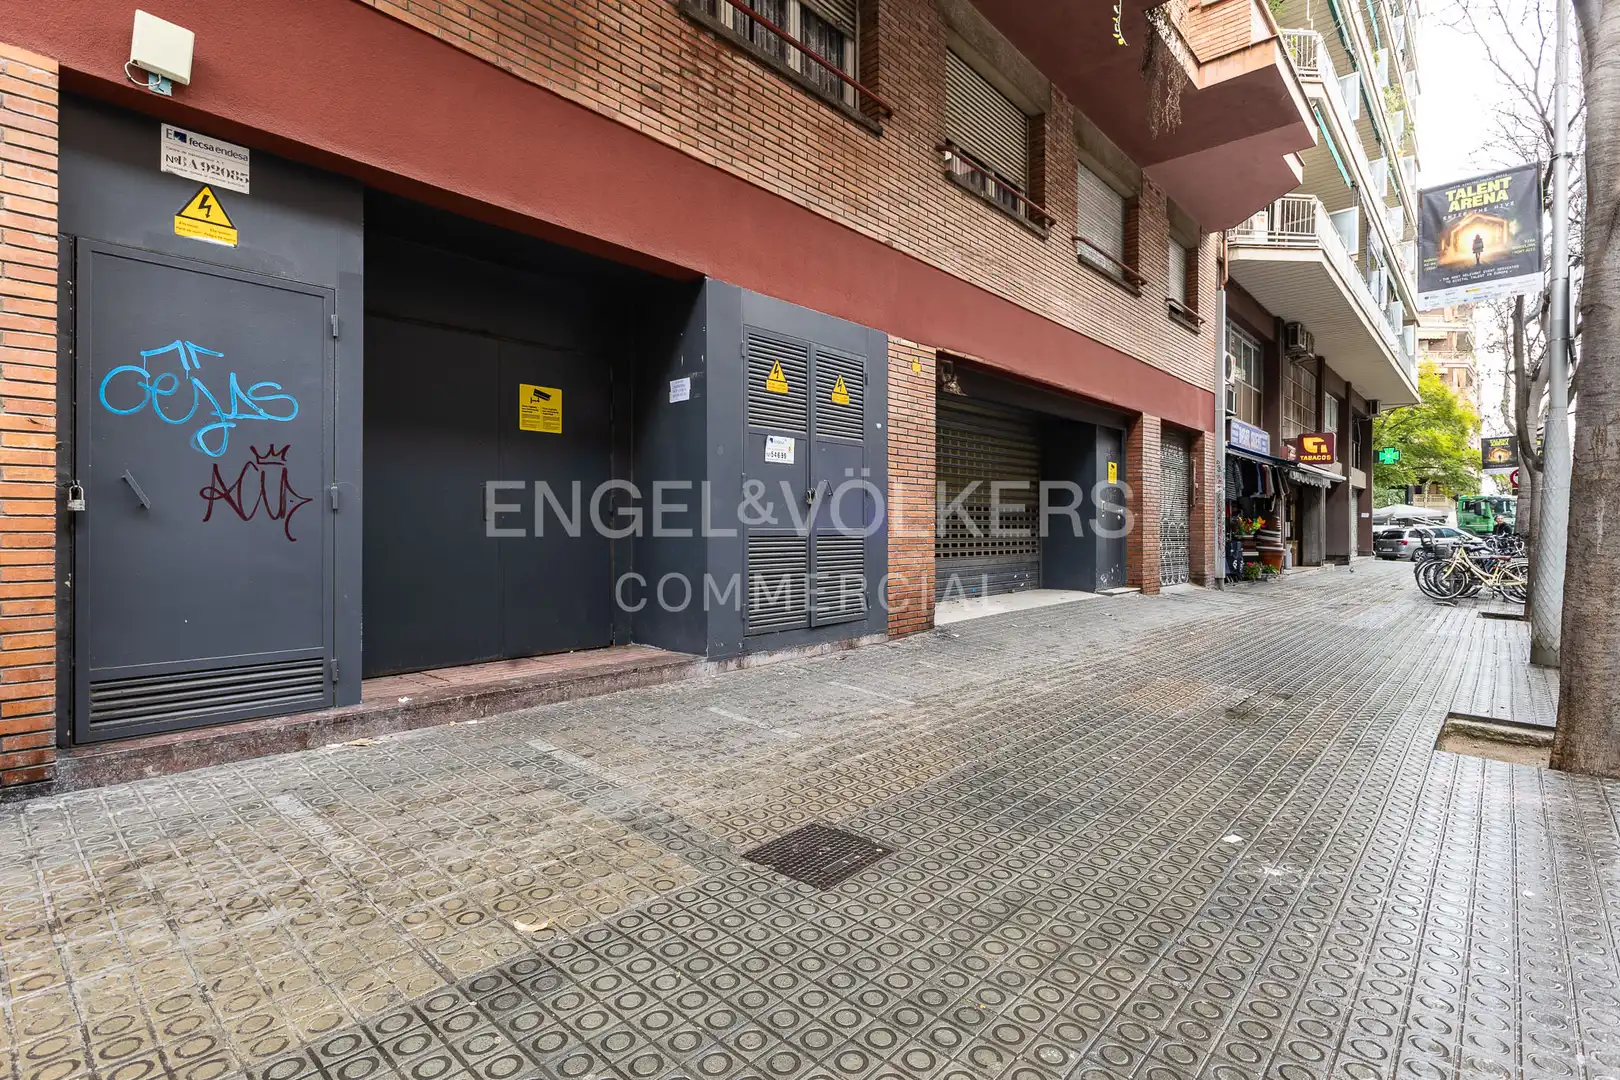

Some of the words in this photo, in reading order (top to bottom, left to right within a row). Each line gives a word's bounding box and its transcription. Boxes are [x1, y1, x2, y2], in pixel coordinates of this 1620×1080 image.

[1445, 176, 1512, 202] TALENT
[1448, 189, 1509, 212] ARENA
[1494, 201, 1515, 209] HIVE
